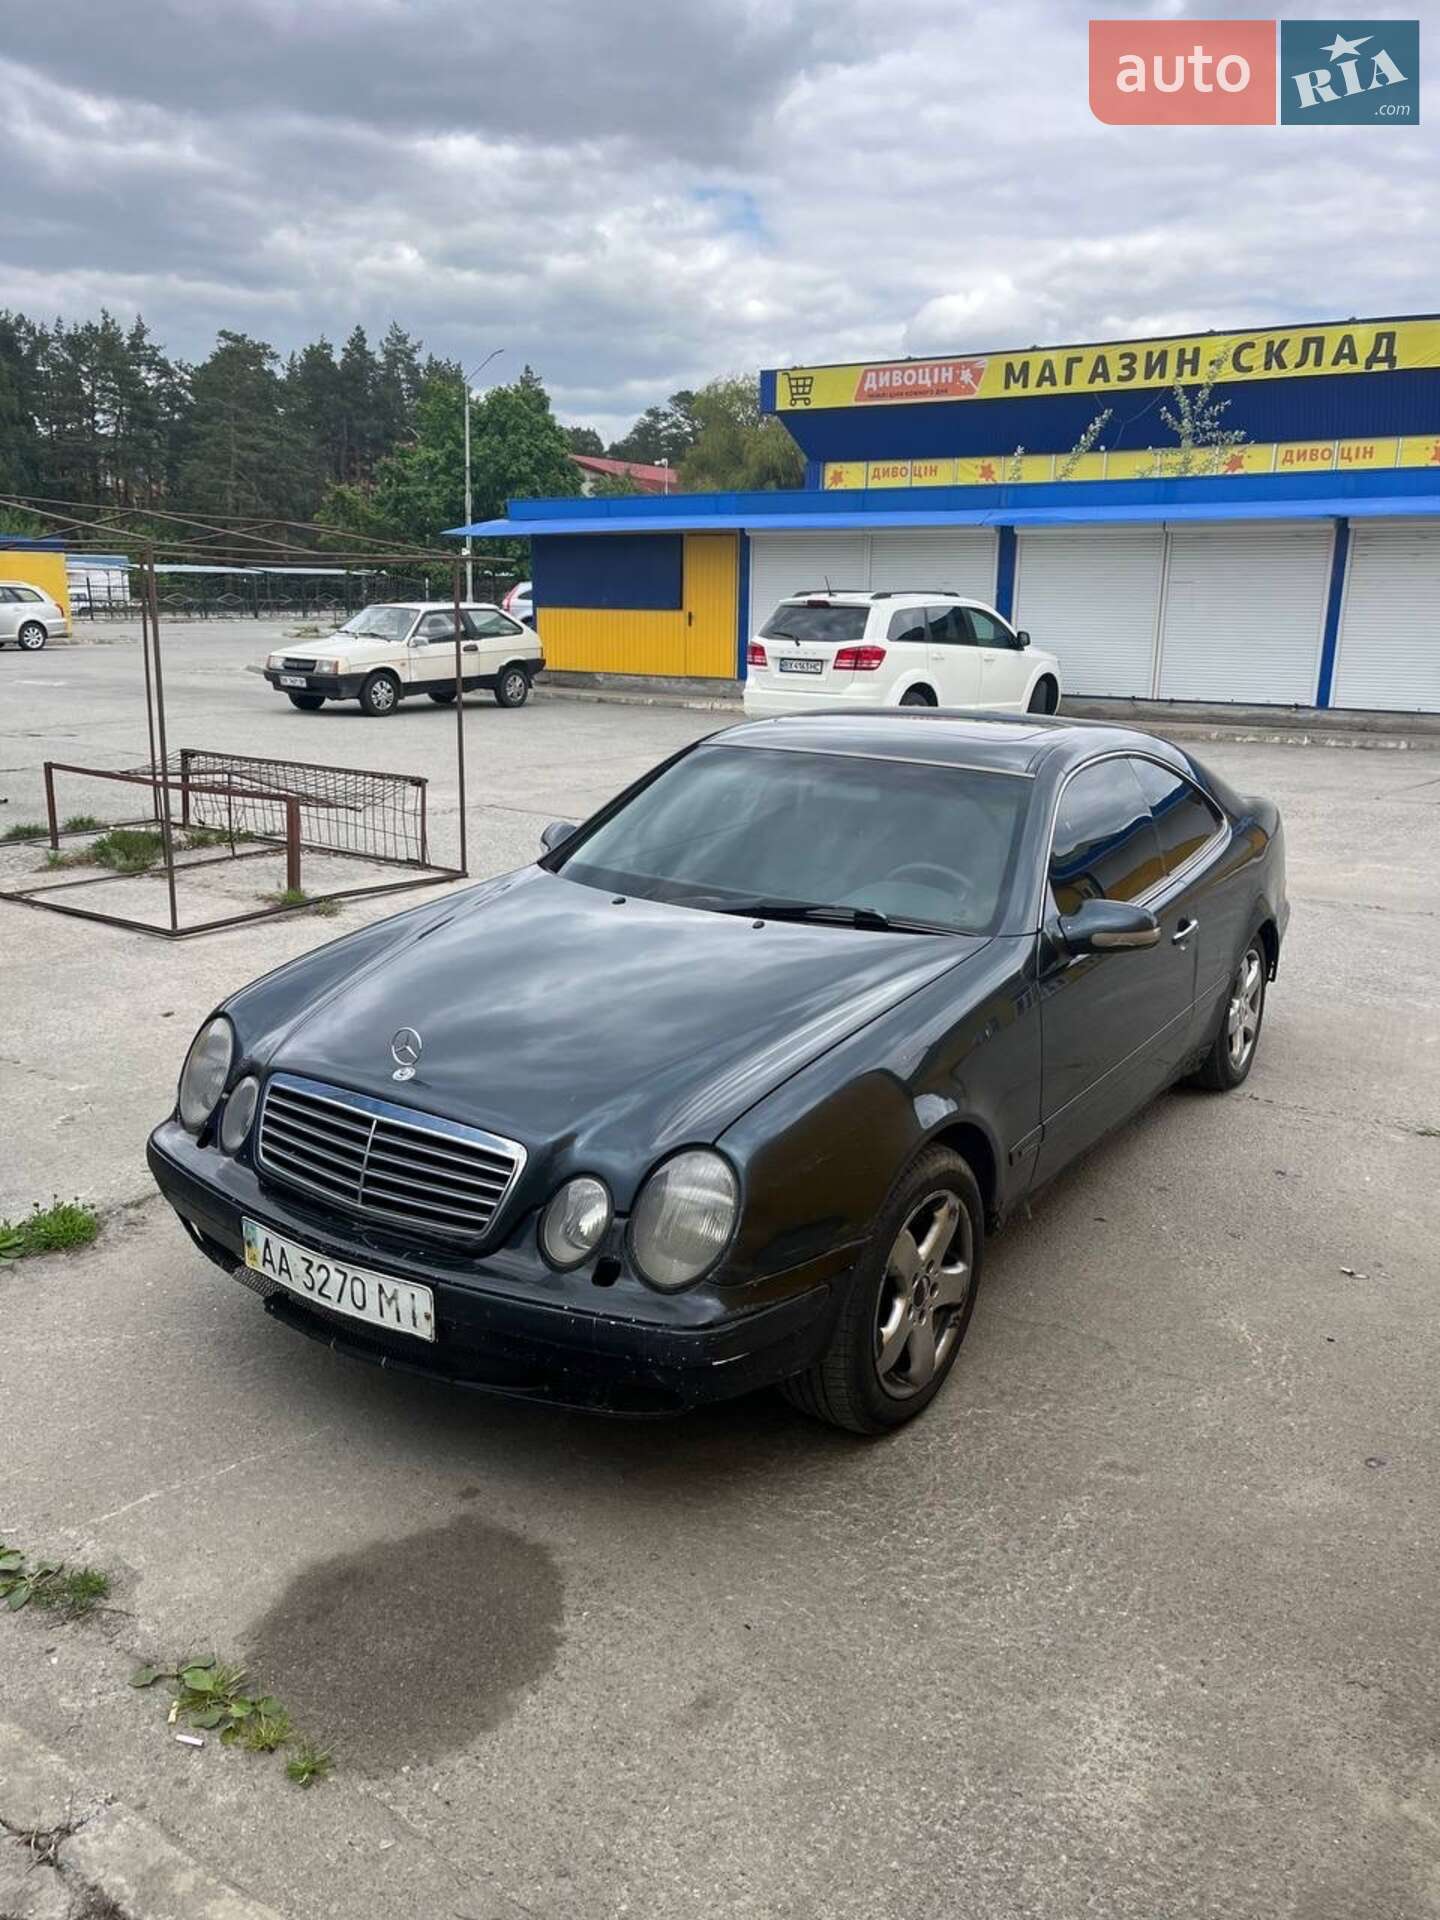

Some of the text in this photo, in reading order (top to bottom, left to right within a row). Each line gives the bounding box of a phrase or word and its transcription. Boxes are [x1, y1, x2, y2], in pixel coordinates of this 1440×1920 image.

[864, 366, 953, 392] ДИВОЦІН
[262, 1237, 293, 1282] AA
[301, 1256, 366, 1311] 3270
